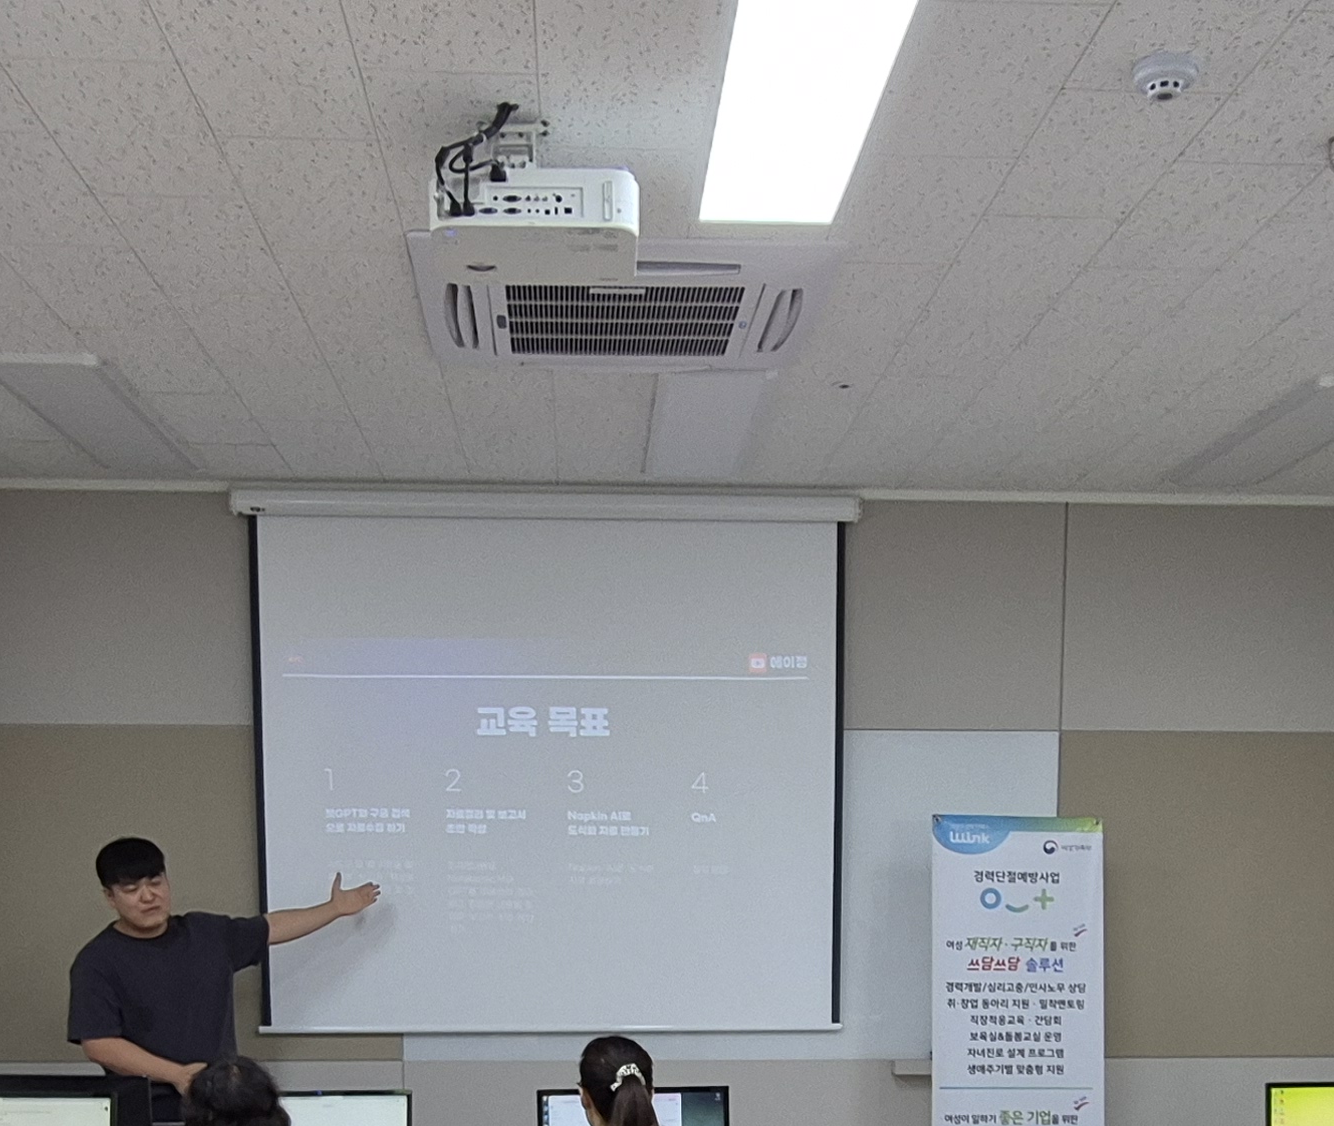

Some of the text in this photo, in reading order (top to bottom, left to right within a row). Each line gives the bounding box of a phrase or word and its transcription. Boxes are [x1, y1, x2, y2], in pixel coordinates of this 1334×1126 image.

[476, 706, 611, 737] 교육 목표
[324, 768, 334, 791] 1
[445, 768, 462, 792] 2
[567, 769, 585, 793] 3
[691, 771, 709, 794] 4
[567, 811, 607, 822] Napkin
[691, 812, 716, 823] QnA
[973, 870, 1061, 885] 경력단절예방사업
[945, 940, 963, 951] 여성
[964, 936, 1004, 951] 재직자
[1060, 941, 1078, 952] 위한
[966, 956, 1065, 973] 쓰담쓰담 솔루션
[1067, 982, 1087, 994] 상담
[981, 998, 1009, 1010] 동아리
[1011, 998, 1030, 1010] 지원
[1039, 998, 1085, 1010] 밀착멘토링
[969, 1014, 1025, 1026] 직장적응교육
[1034, 1015, 1062, 1026] 간담회
[1043, 1031, 1062, 1043] 운영
[966, 1048, 1065, 1059] 자녀진로 설계 프로그램
[966, 1064, 1065, 1075] 생애주기별 맞춤형 지원
[944, 1114, 970, 1125] 여성이
[971, 1113, 997, 1125] 일하기
[999, 1110, 1023, 1126] 좋은
[1061, 1114, 1078, 1126] 위한
